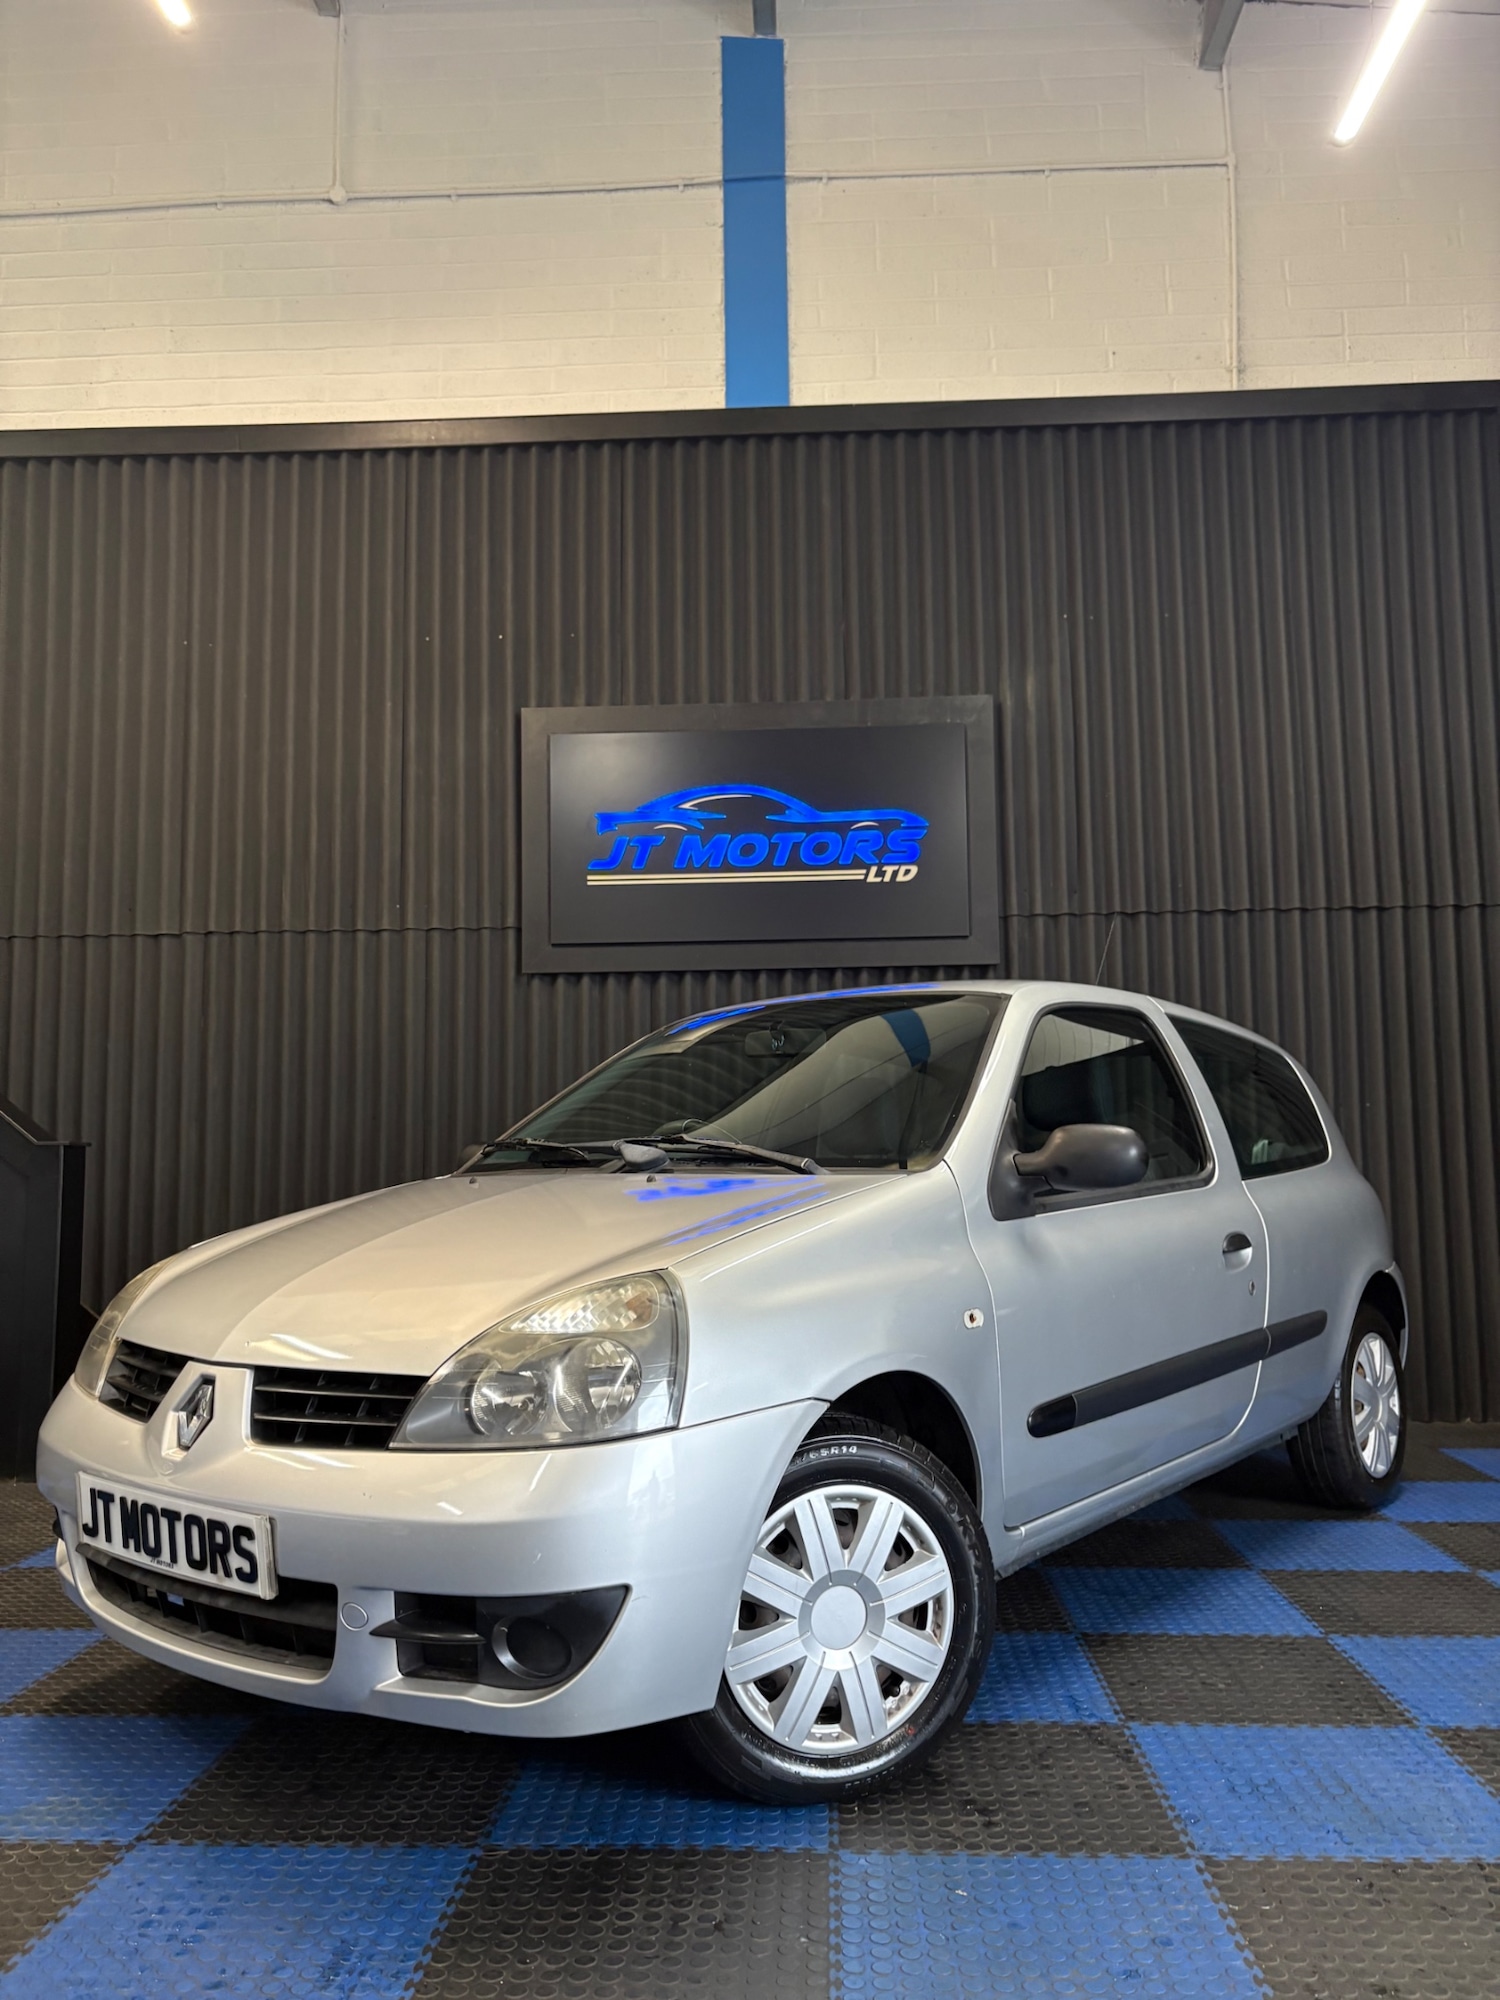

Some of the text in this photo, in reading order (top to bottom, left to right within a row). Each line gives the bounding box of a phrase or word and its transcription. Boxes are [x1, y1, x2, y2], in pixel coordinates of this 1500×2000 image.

[588, 828, 928, 871] JT MOTORS
[866, 864, 919, 884] LTD
[82, 1487, 259, 1584] JT MOTORS
